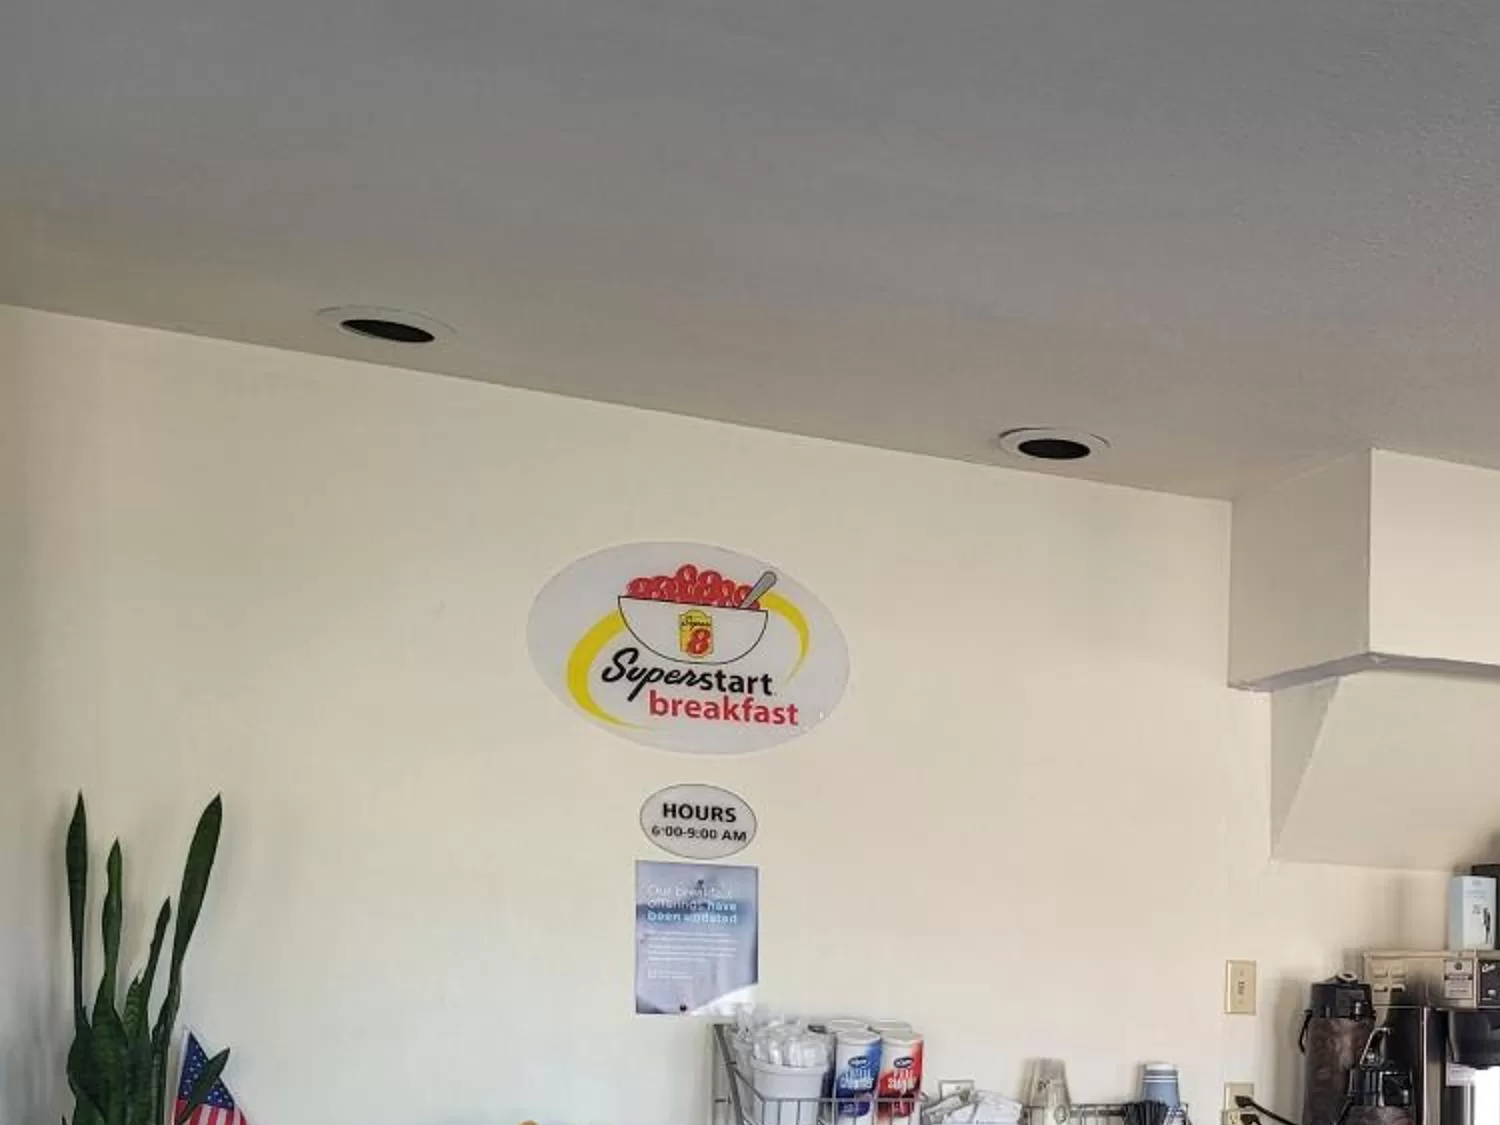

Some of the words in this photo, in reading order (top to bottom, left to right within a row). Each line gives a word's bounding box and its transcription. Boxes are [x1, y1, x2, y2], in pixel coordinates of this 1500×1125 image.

[686, 629, 711, 656] 8
[601, 647, 773, 702] Superstart
[649, 690, 799, 726] breakfast
[662, 803, 737, 823] HOURS
[721, 830, 747, 842] AM
